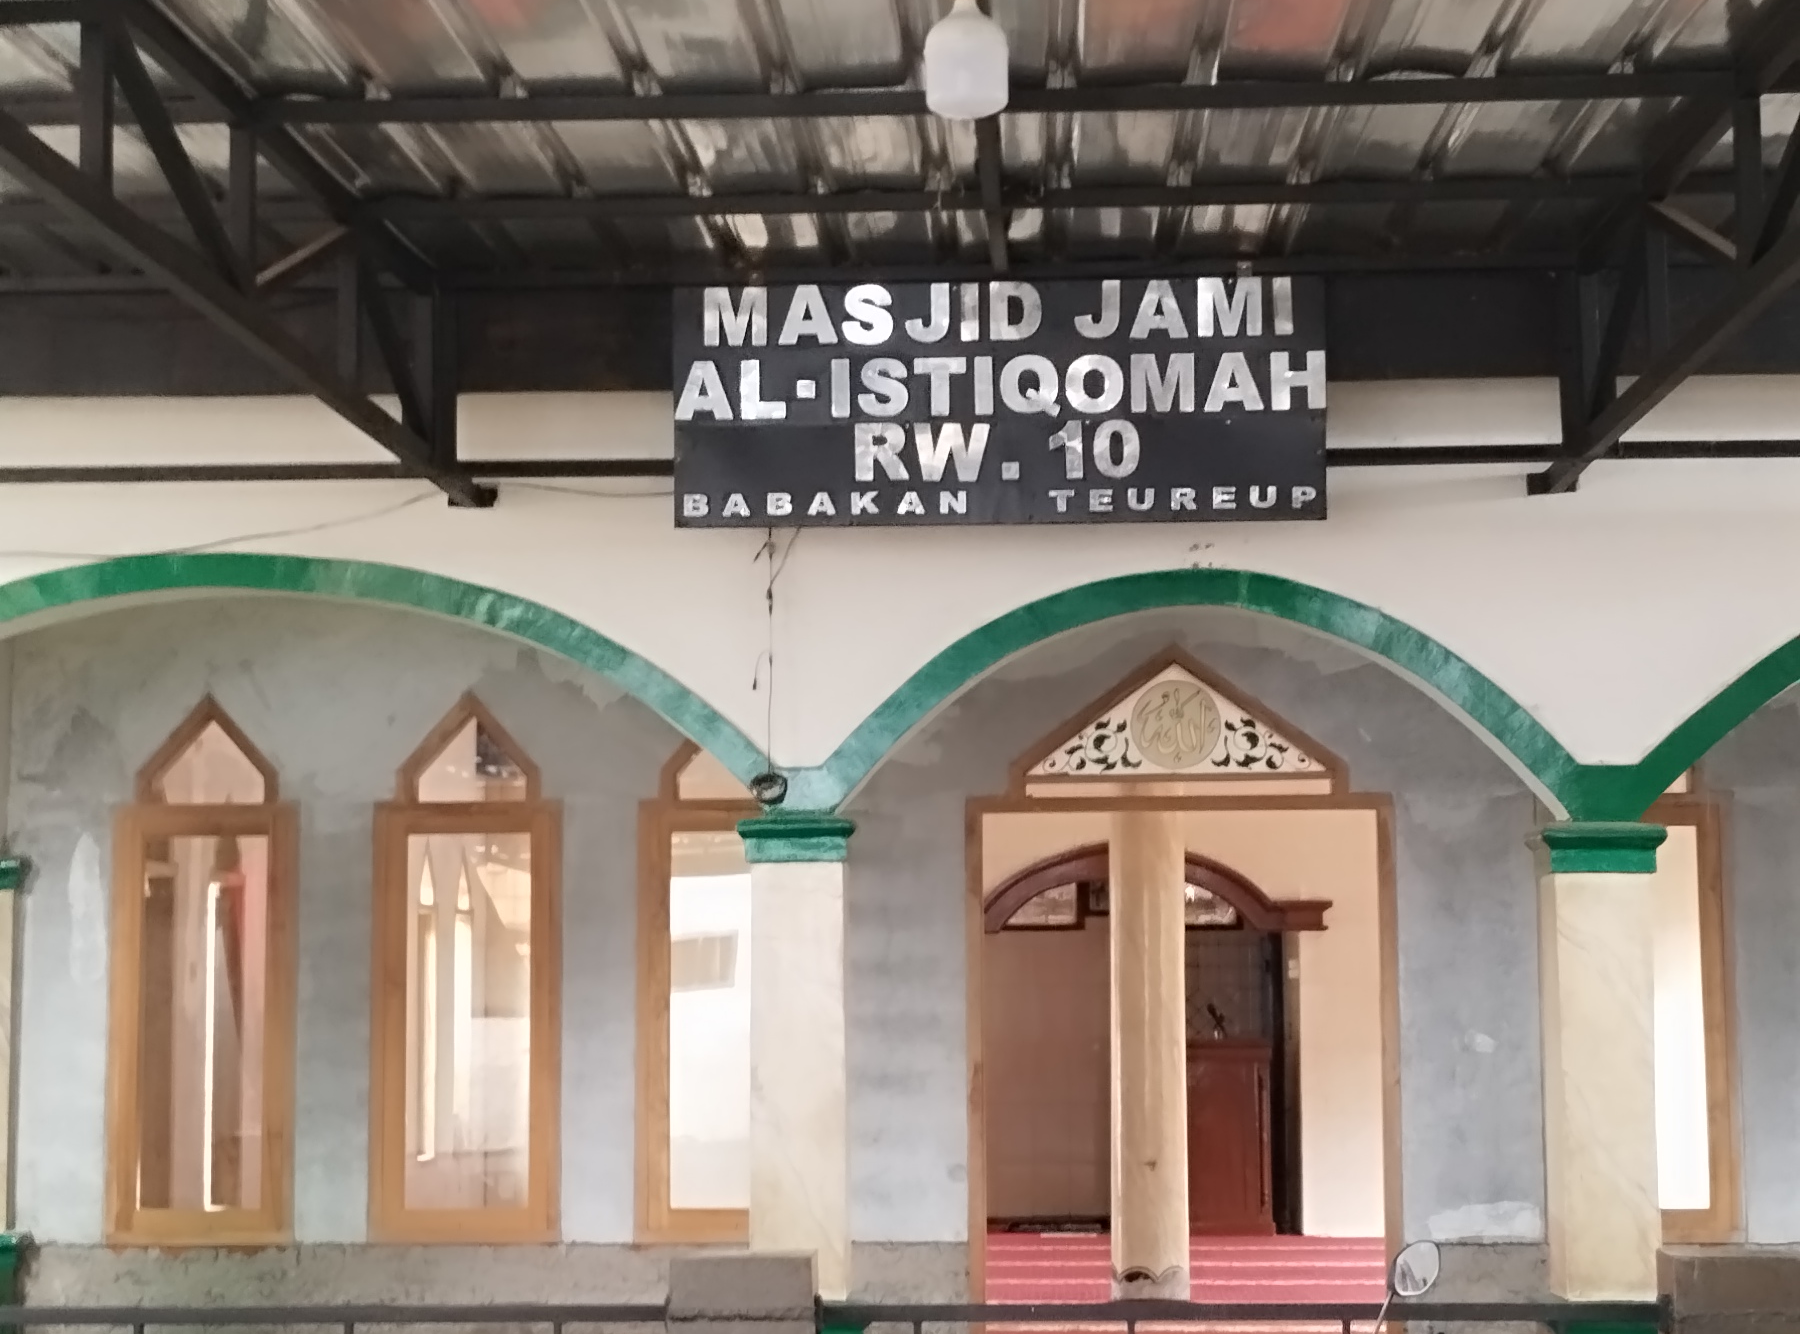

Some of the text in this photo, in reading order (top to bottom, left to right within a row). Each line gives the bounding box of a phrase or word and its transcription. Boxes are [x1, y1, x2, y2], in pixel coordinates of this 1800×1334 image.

[703, 277, 1296, 347] MASJID JAMI
[674, 350, 1327, 420] AL-ISTIQOMAH
[854, 419, 1141, 482] RW. 10
[683, 485, 1318, 517] BABAKAN TEUREUP
